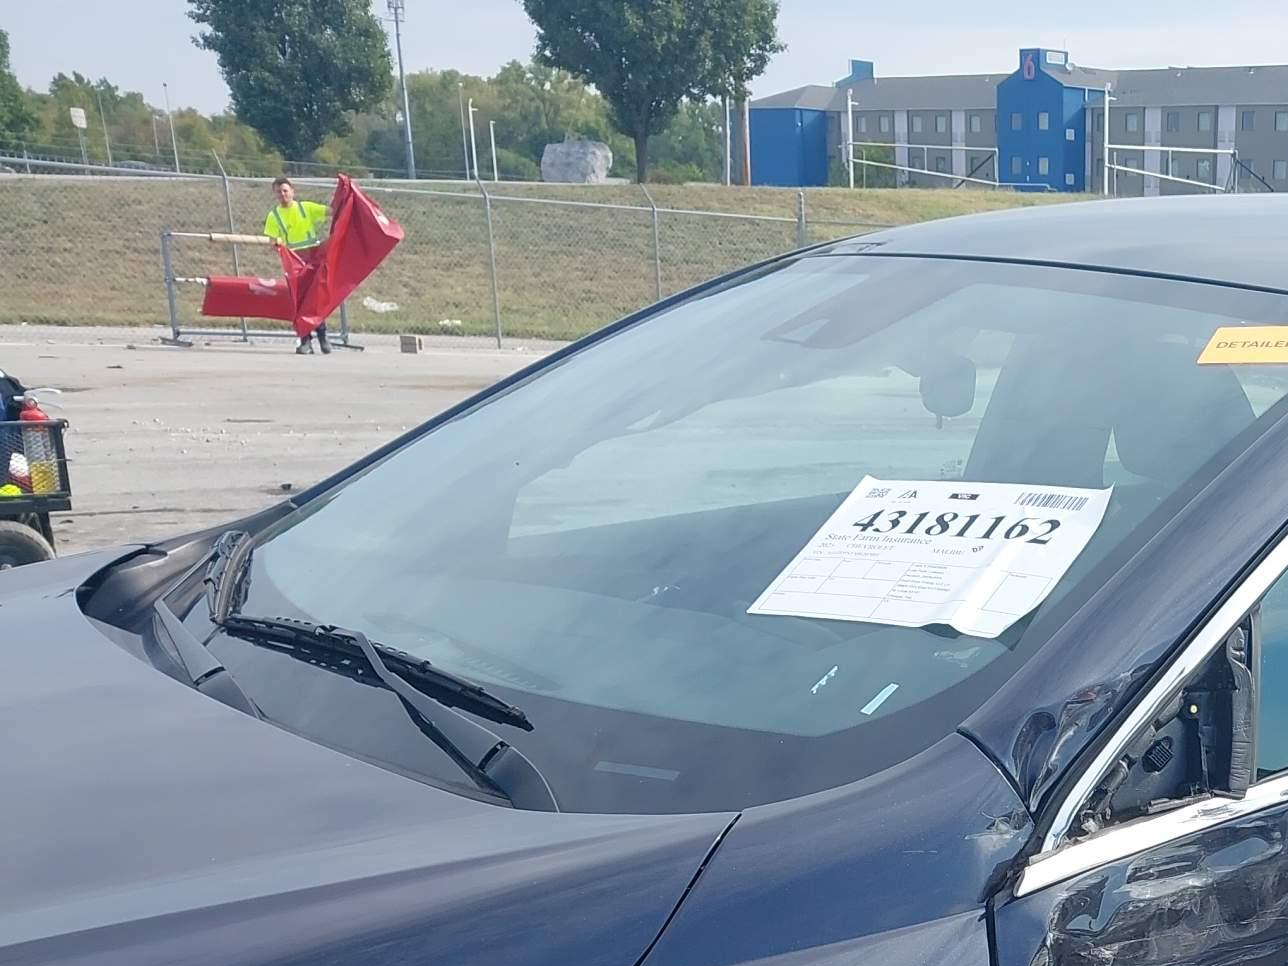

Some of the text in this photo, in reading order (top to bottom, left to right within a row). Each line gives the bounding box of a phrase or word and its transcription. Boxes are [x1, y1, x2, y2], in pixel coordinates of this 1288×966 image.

[1023, 53, 1035, 81] 6
[825, 532, 933, 545] State Farm Insurance
[852, 508, 1061, 545] 43181162
